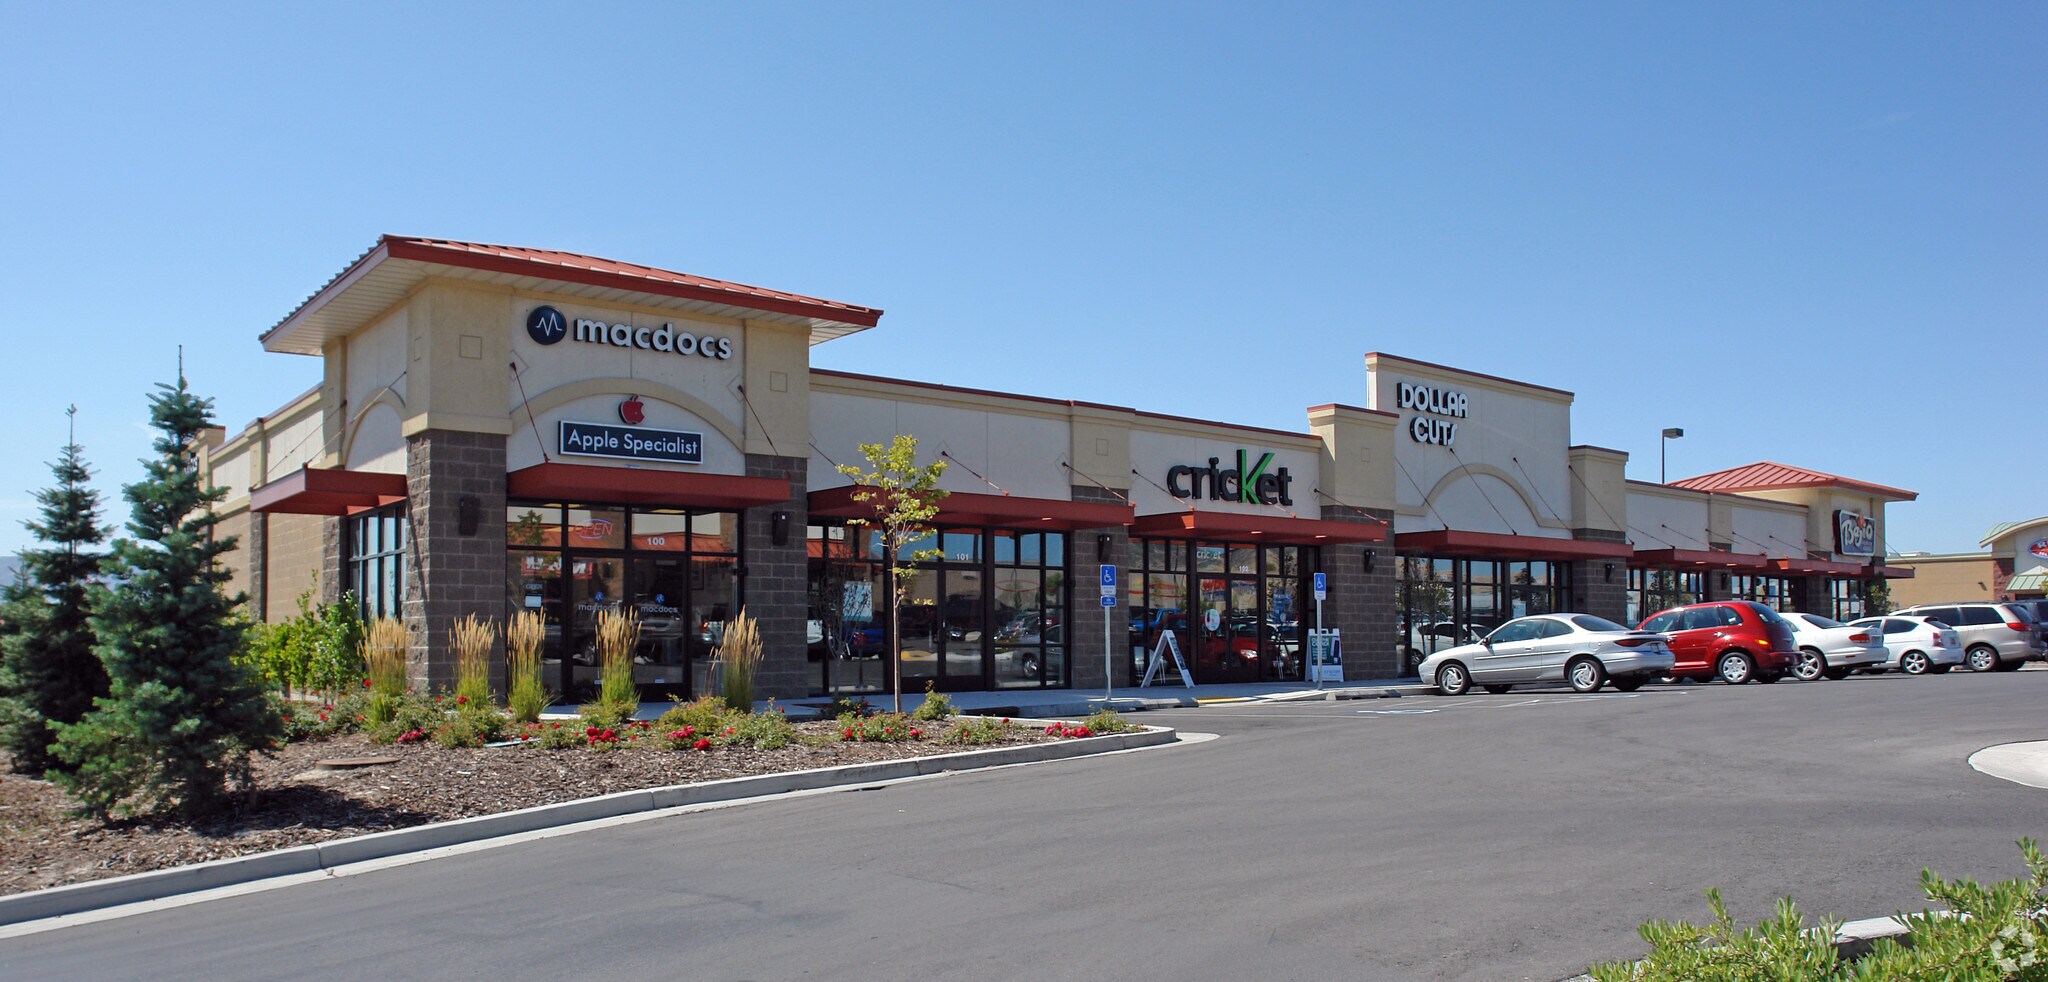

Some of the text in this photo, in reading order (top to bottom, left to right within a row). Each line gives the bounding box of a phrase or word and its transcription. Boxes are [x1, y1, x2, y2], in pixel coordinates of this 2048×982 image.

[574, 318, 732, 360] macdocs
[1398, 383, 1469, 418] DOLLAR
[1411, 416, 1458, 446] CUTS
[567, 428, 698, 455] Apple Specialist
[574, 522, 613, 536] OPEN
[647, 537, 665, 546] 100
[956, 553, 969, 561] 101
[640, 605, 678, 613] macdocs
